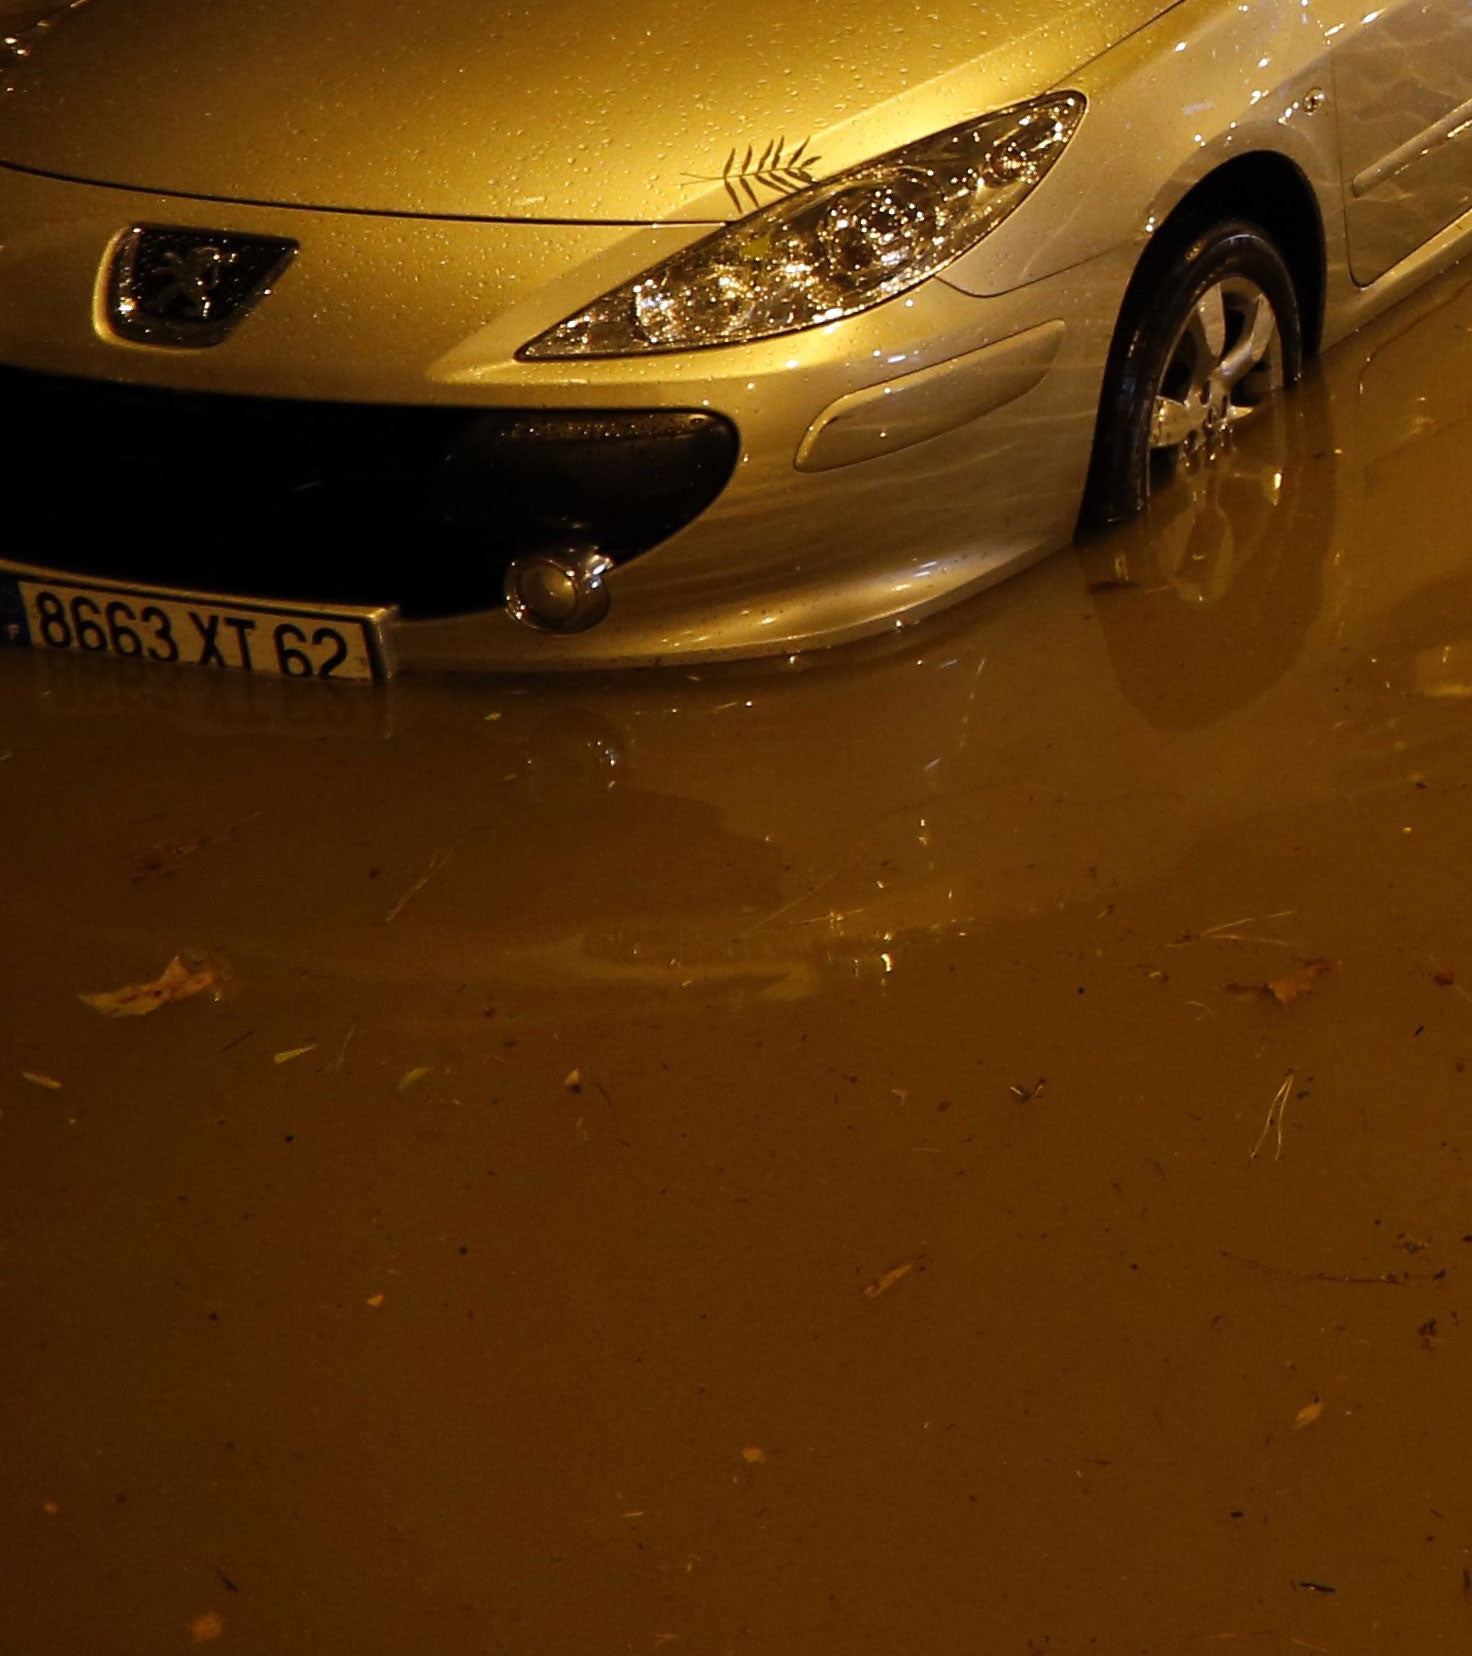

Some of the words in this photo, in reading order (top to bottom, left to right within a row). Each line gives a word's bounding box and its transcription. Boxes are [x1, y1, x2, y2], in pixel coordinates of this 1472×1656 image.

[35, 591, 179, 663] 8663
[188, 611, 256, 671] XT
[273, 622, 348, 679] 62
